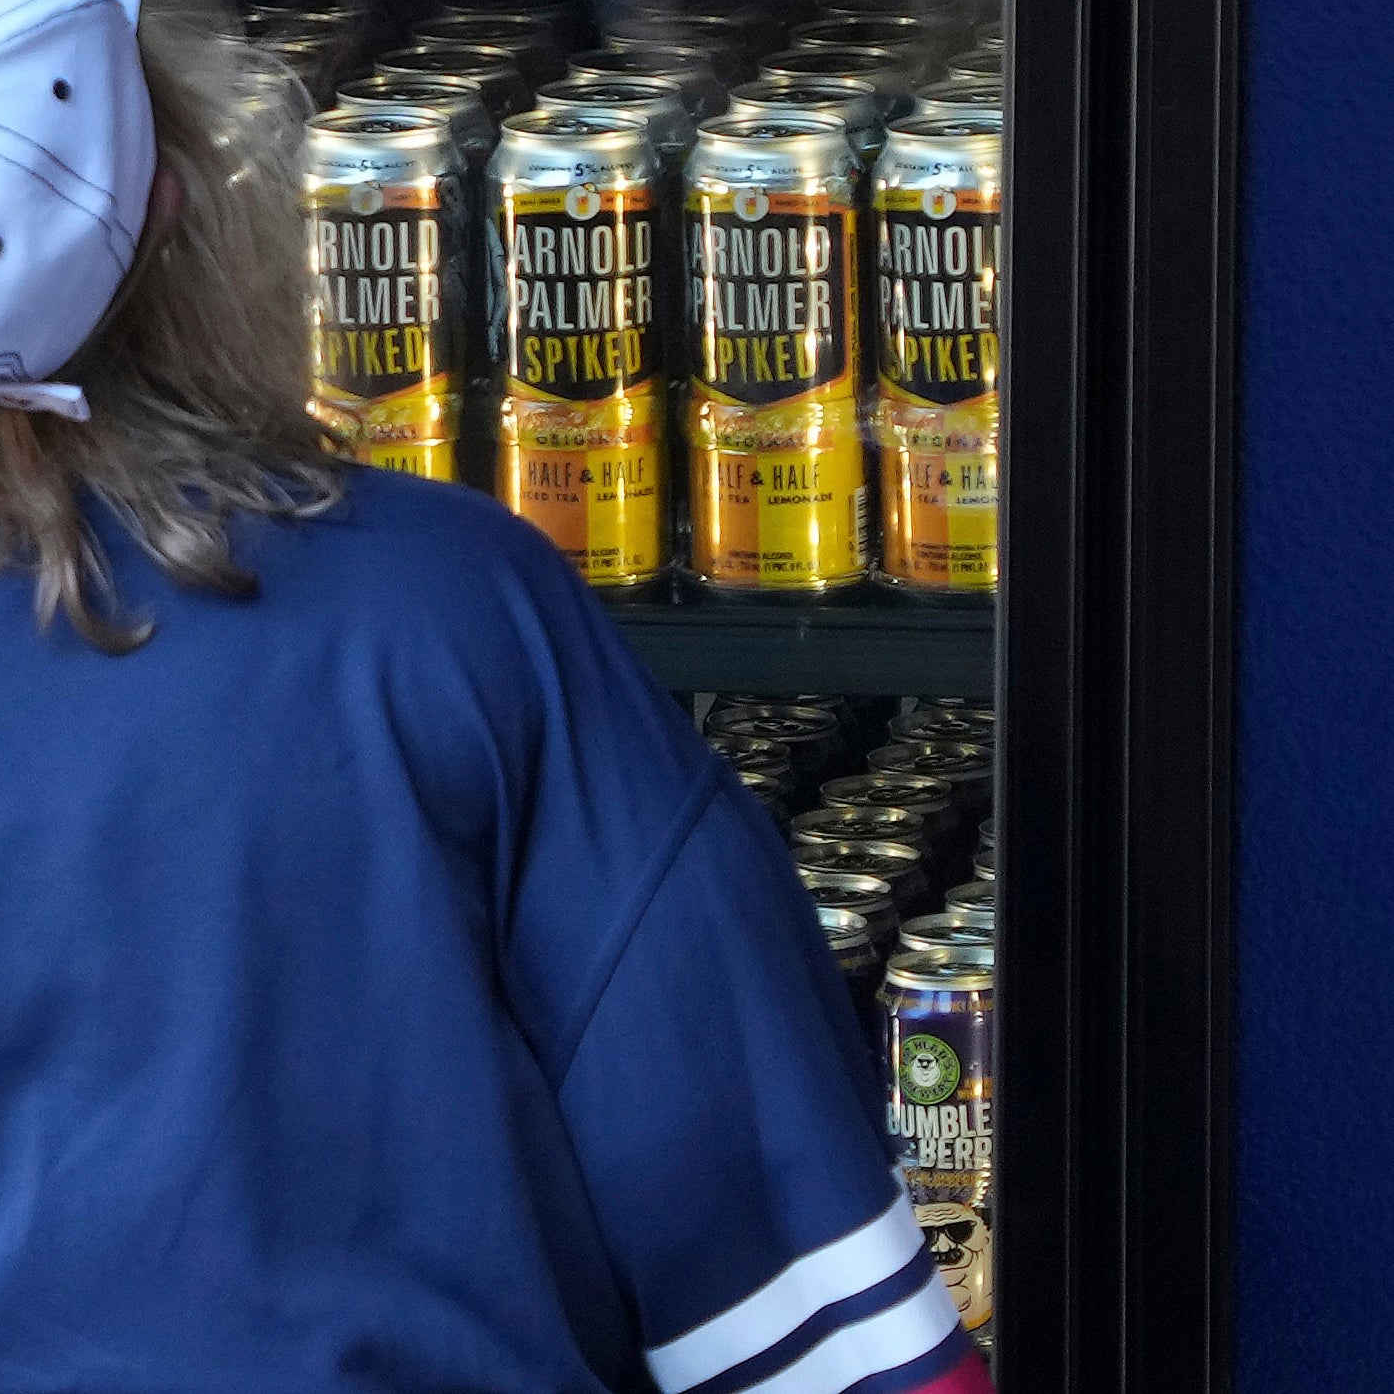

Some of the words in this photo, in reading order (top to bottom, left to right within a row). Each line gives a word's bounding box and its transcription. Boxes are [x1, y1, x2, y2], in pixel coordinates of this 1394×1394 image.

[513, 219, 652, 276] ARNOLD
[691, 223, 832, 277] ARNOLD
[515, 277, 653, 331] PALMER
[691, 279, 833, 332] PALMER
[528, 459, 574, 488] HALF
[601, 456, 647, 487] HALF
[772, 461, 821, 489] HALF
[767, 492, 834, 506] LEMONADE
